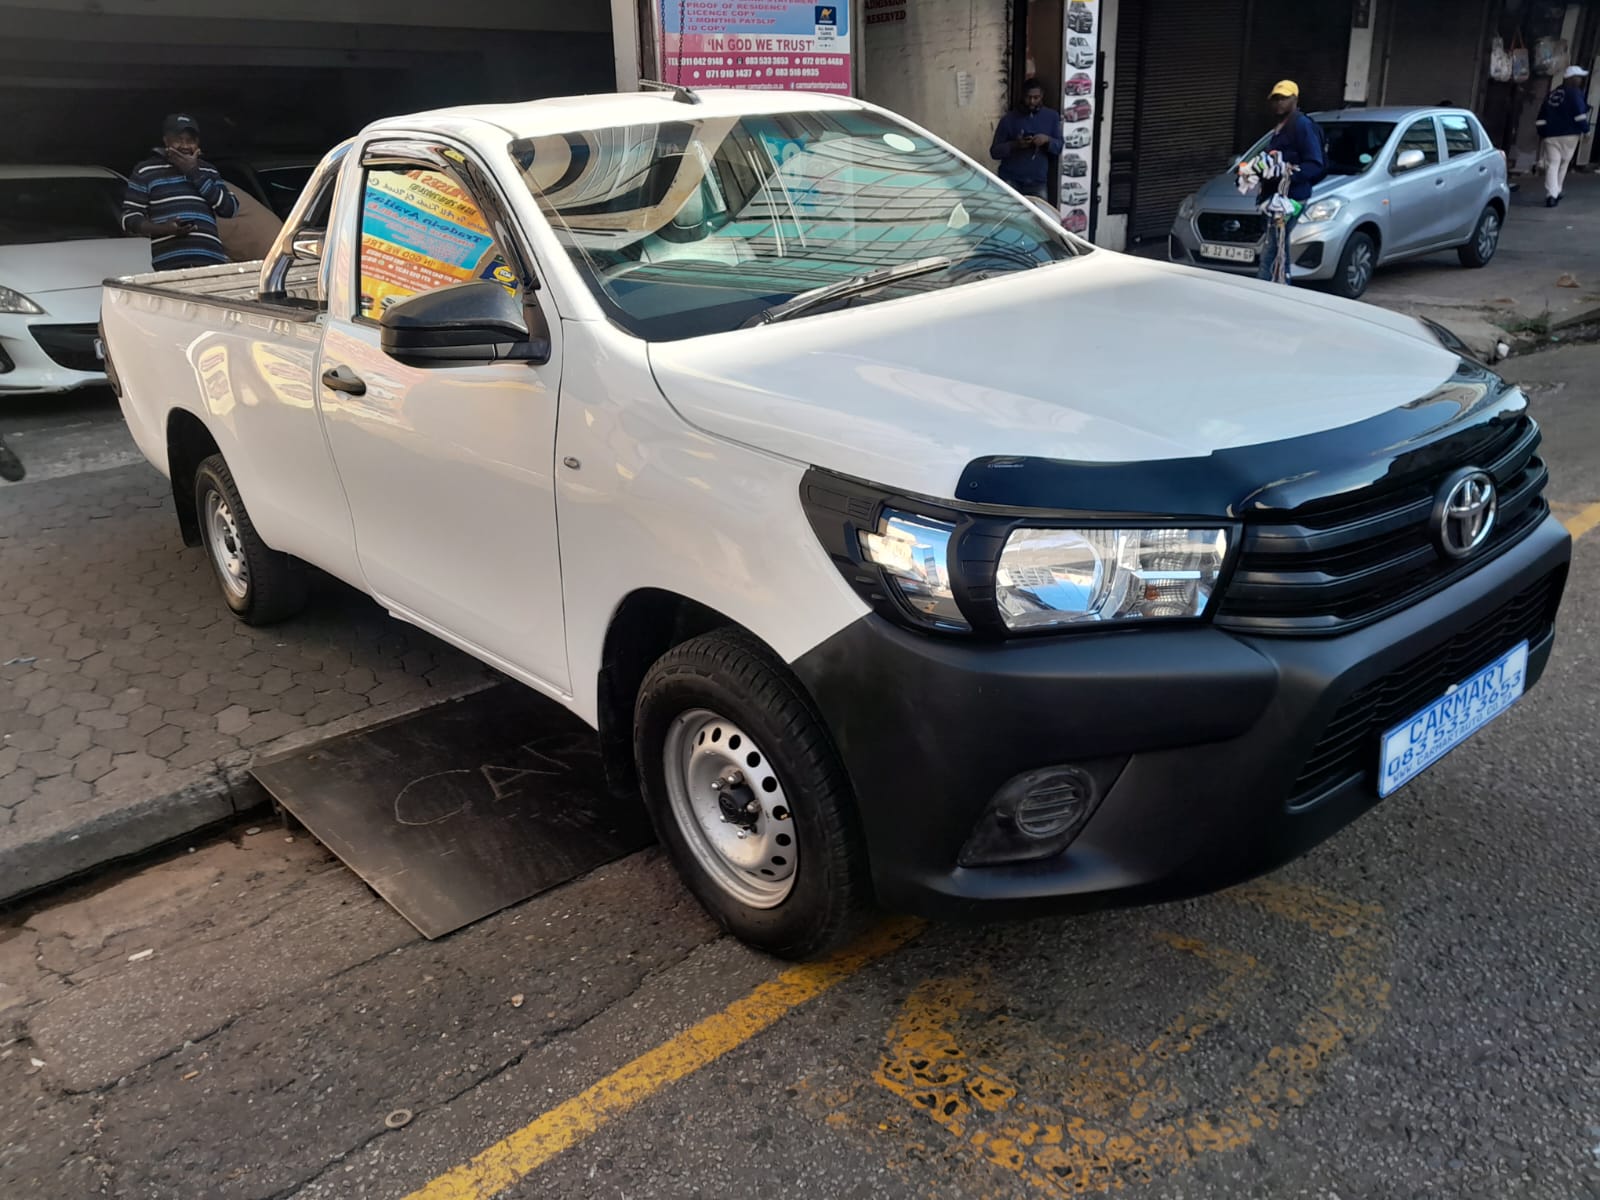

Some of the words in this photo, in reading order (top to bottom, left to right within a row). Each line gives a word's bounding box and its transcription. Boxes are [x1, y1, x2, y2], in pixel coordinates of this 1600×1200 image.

[728, 38, 752, 50] GOD
[755, 39, 772, 51] WE
[1387, 737, 1428, 777] 083
[1433, 706, 1471, 744] 533
[1476, 670, 1522, 713] 3653
[1410, 658, 1508, 745] CARMART
